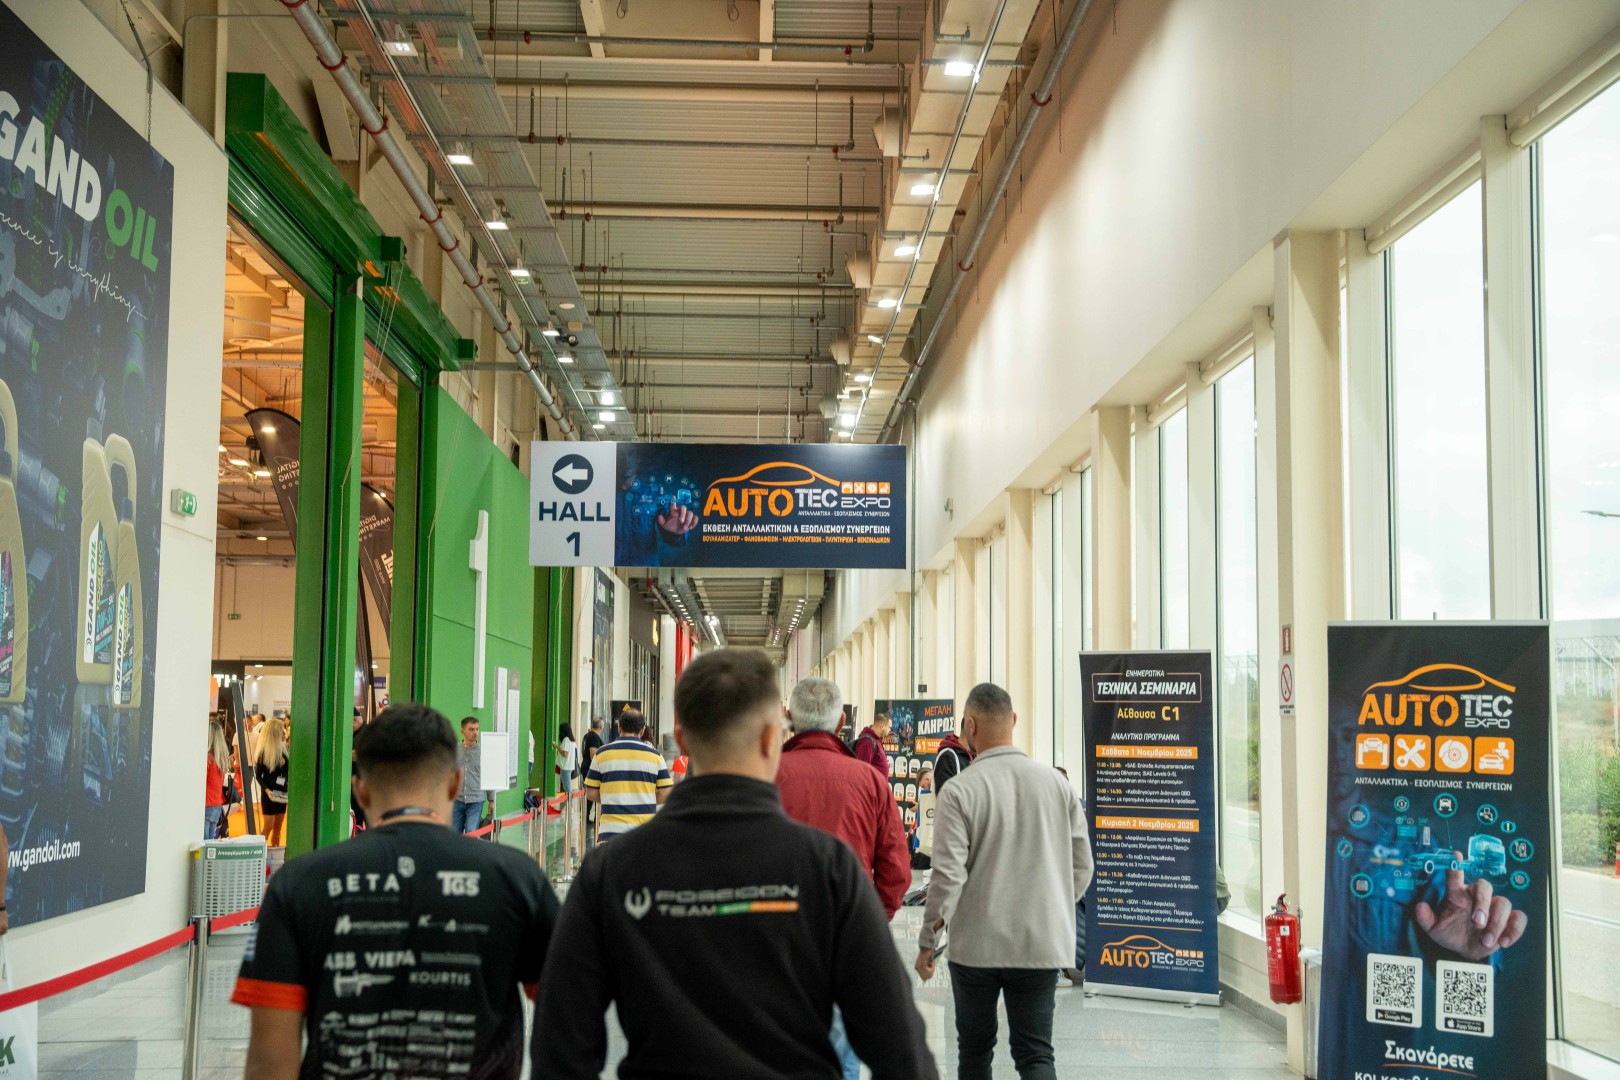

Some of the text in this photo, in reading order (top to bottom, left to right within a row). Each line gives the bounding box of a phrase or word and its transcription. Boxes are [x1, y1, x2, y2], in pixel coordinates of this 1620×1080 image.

[0, 90, 158, 272] GAND OIL
[841, 497, 890, 508] EXPO
[538, 502, 610, 522] HALL
[702, 524, 890, 534] ΕΚΘΕΣΗ ΑΝΤΑΛΛΑΚΤΙΚΩΝ & ΕΞΟΠΛΙΣΜΟΥ ΣΥΝΕΡΓΕΙΩΝ
[566, 532, 580, 557] 1
[1097, 682, 1196, 695] ΤΕΧΝΙΚΑ ΣΕΜΙΝΑΡΙΑ
[924, 704, 952, 717] ΜΕΓΑΛΗ
[1117, 706, 1180, 721] Αίθουσα C1
[1464, 718, 1510, 729] EXPO
[1111, 733, 1180, 741] ΑΝΑΛΥΤΙΚΟ ΠΡΟΓΡΑΜΜΑ
[1137, 748, 1174, 757] Νοεμβρίου
[1355, 777, 1512, 791] ΑΝΤΑΛΛΑΚΤΙΚΑ ΕΞΟΠΛΙΣΜΟΣ ΣΥΝΕΡΓΕΙΩΝ
[1102, 819, 1131, 827] Κυριακή
[1139, 820, 1176, 829] Νοεμβρίου
[1178, 821, 1194, 829] 2025
[327, 873, 400, 897] BETA
[436, 871, 481, 896] TGS
[656, 885, 799, 903] POSEIDON
[658, 904, 718, 917] TEAM
[1176, 958, 1204, 968] EXPO
[1385, 1013, 1411, 1022] Google Play
[1384, 1040, 1474, 1070] Σκανάρετε
